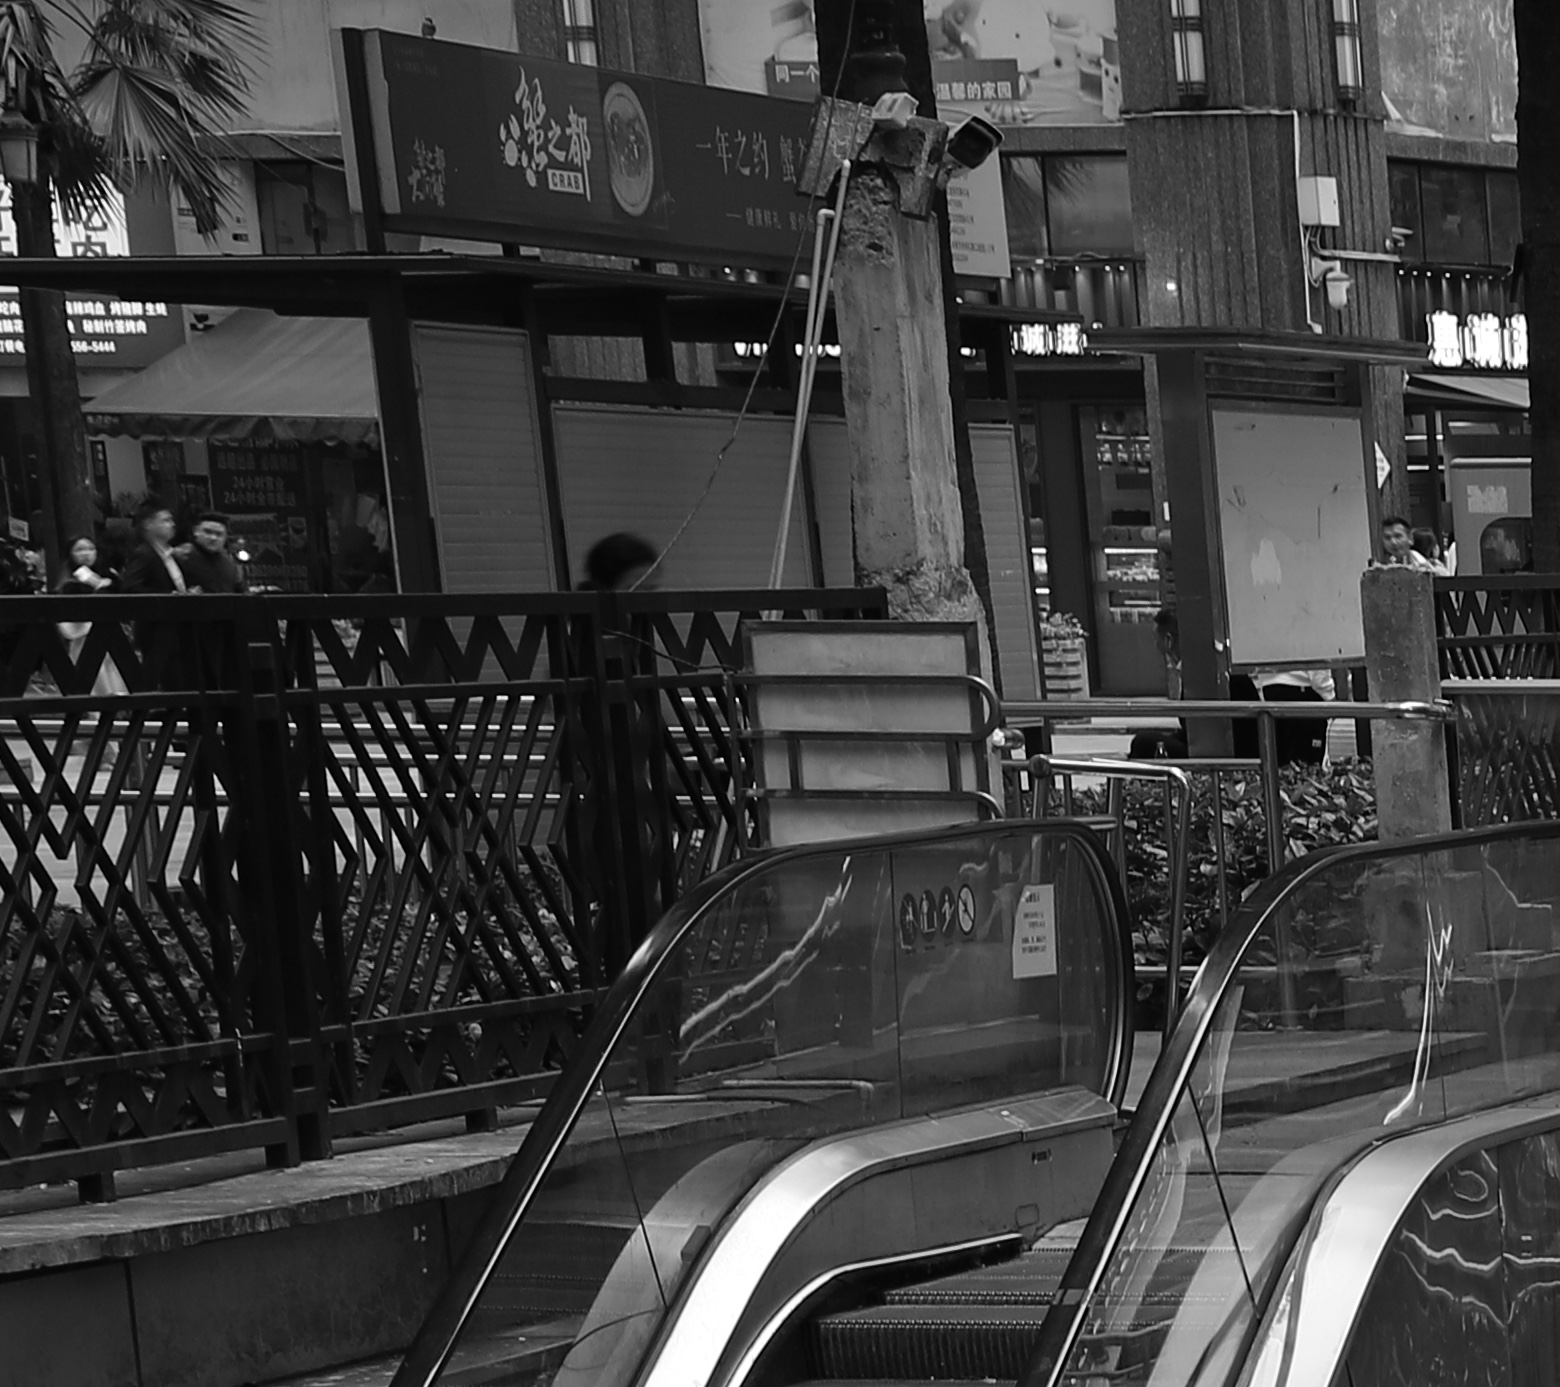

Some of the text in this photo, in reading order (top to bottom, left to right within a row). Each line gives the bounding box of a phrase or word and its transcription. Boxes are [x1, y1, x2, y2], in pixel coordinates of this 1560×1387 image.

[775, 64, 820, 83] 同一个
[697, 126, 769, 180] 一年之约
[550, 171, 583, 191] CRAB
